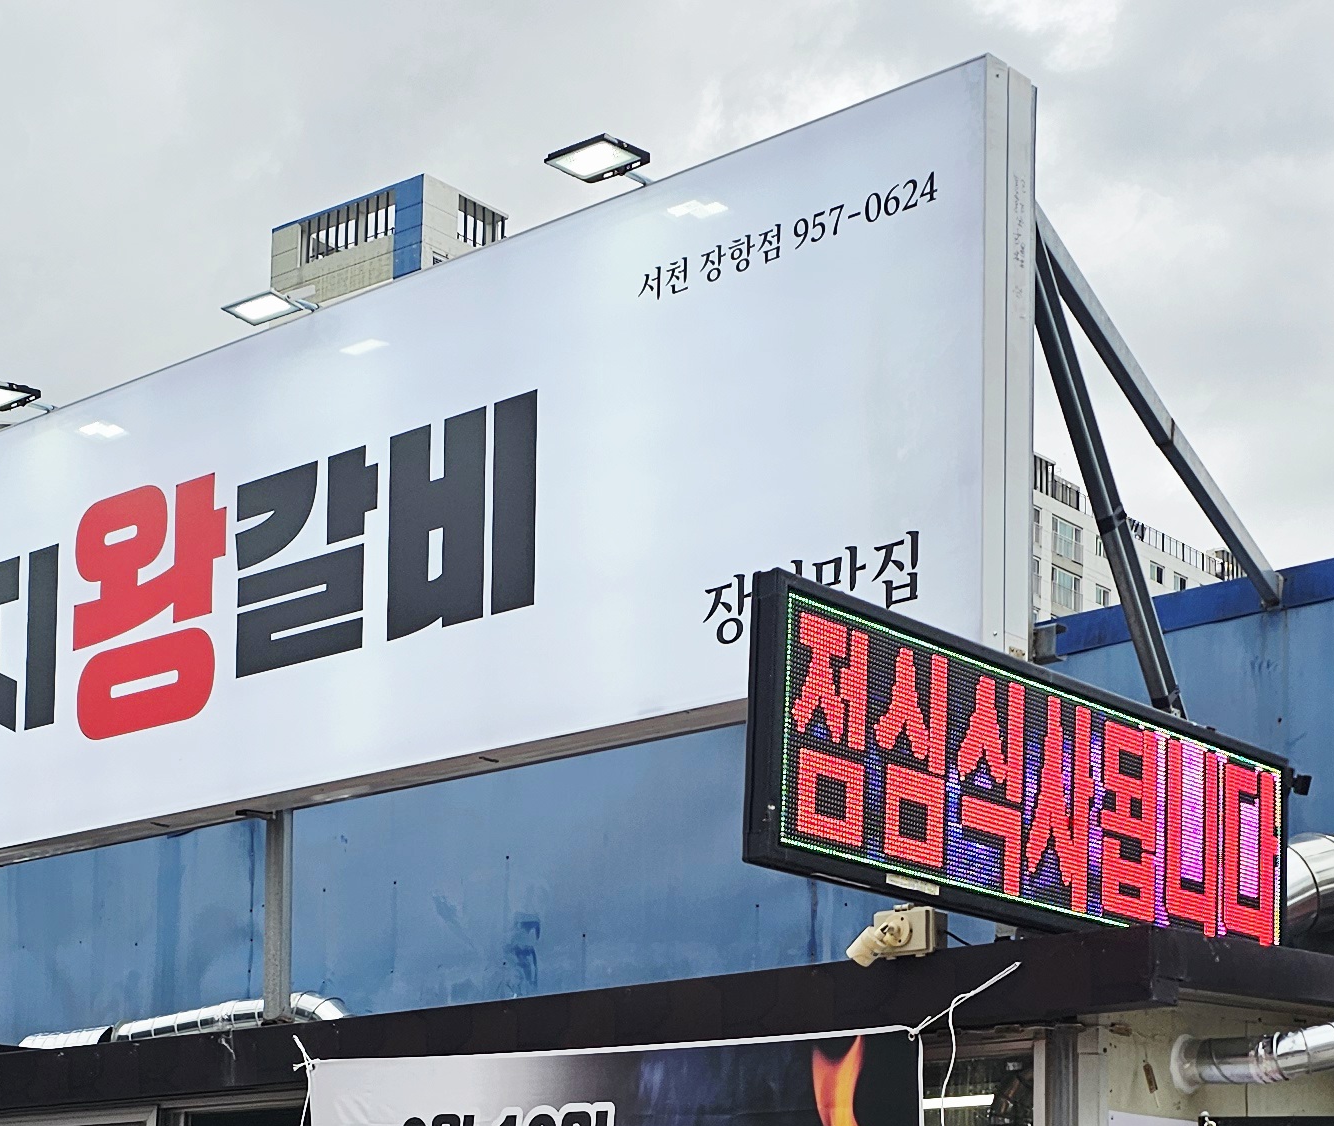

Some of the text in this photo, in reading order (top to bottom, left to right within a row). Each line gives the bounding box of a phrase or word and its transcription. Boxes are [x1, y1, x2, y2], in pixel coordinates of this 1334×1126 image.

[638, 171, 938, 300] 서천 장항점 957-0624
[703, 530, 920, 645] 장맛집
